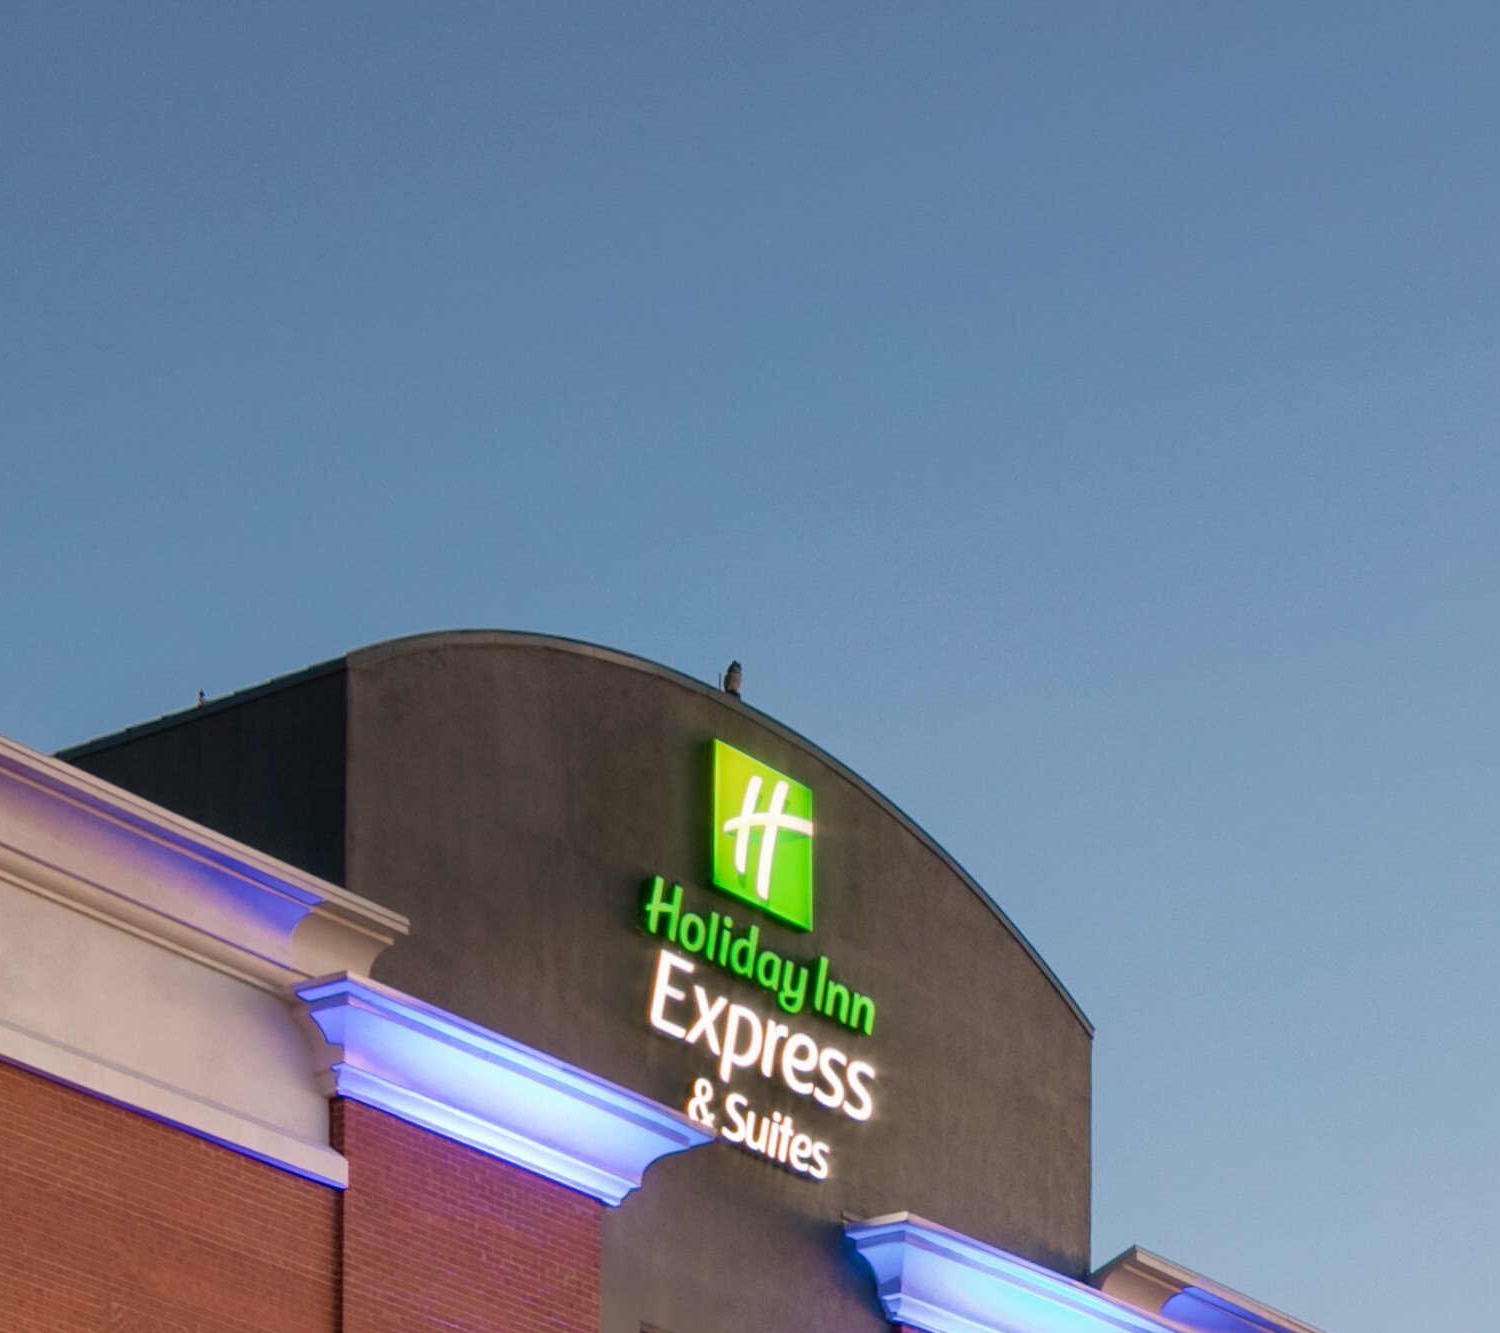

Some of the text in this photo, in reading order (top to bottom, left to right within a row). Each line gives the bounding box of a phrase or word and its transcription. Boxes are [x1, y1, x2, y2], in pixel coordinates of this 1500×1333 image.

[645, 876, 876, 1036] Holiday Inn
[650, 948, 877, 1122] Express
[687, 1077, 831, 1180] & Suites
